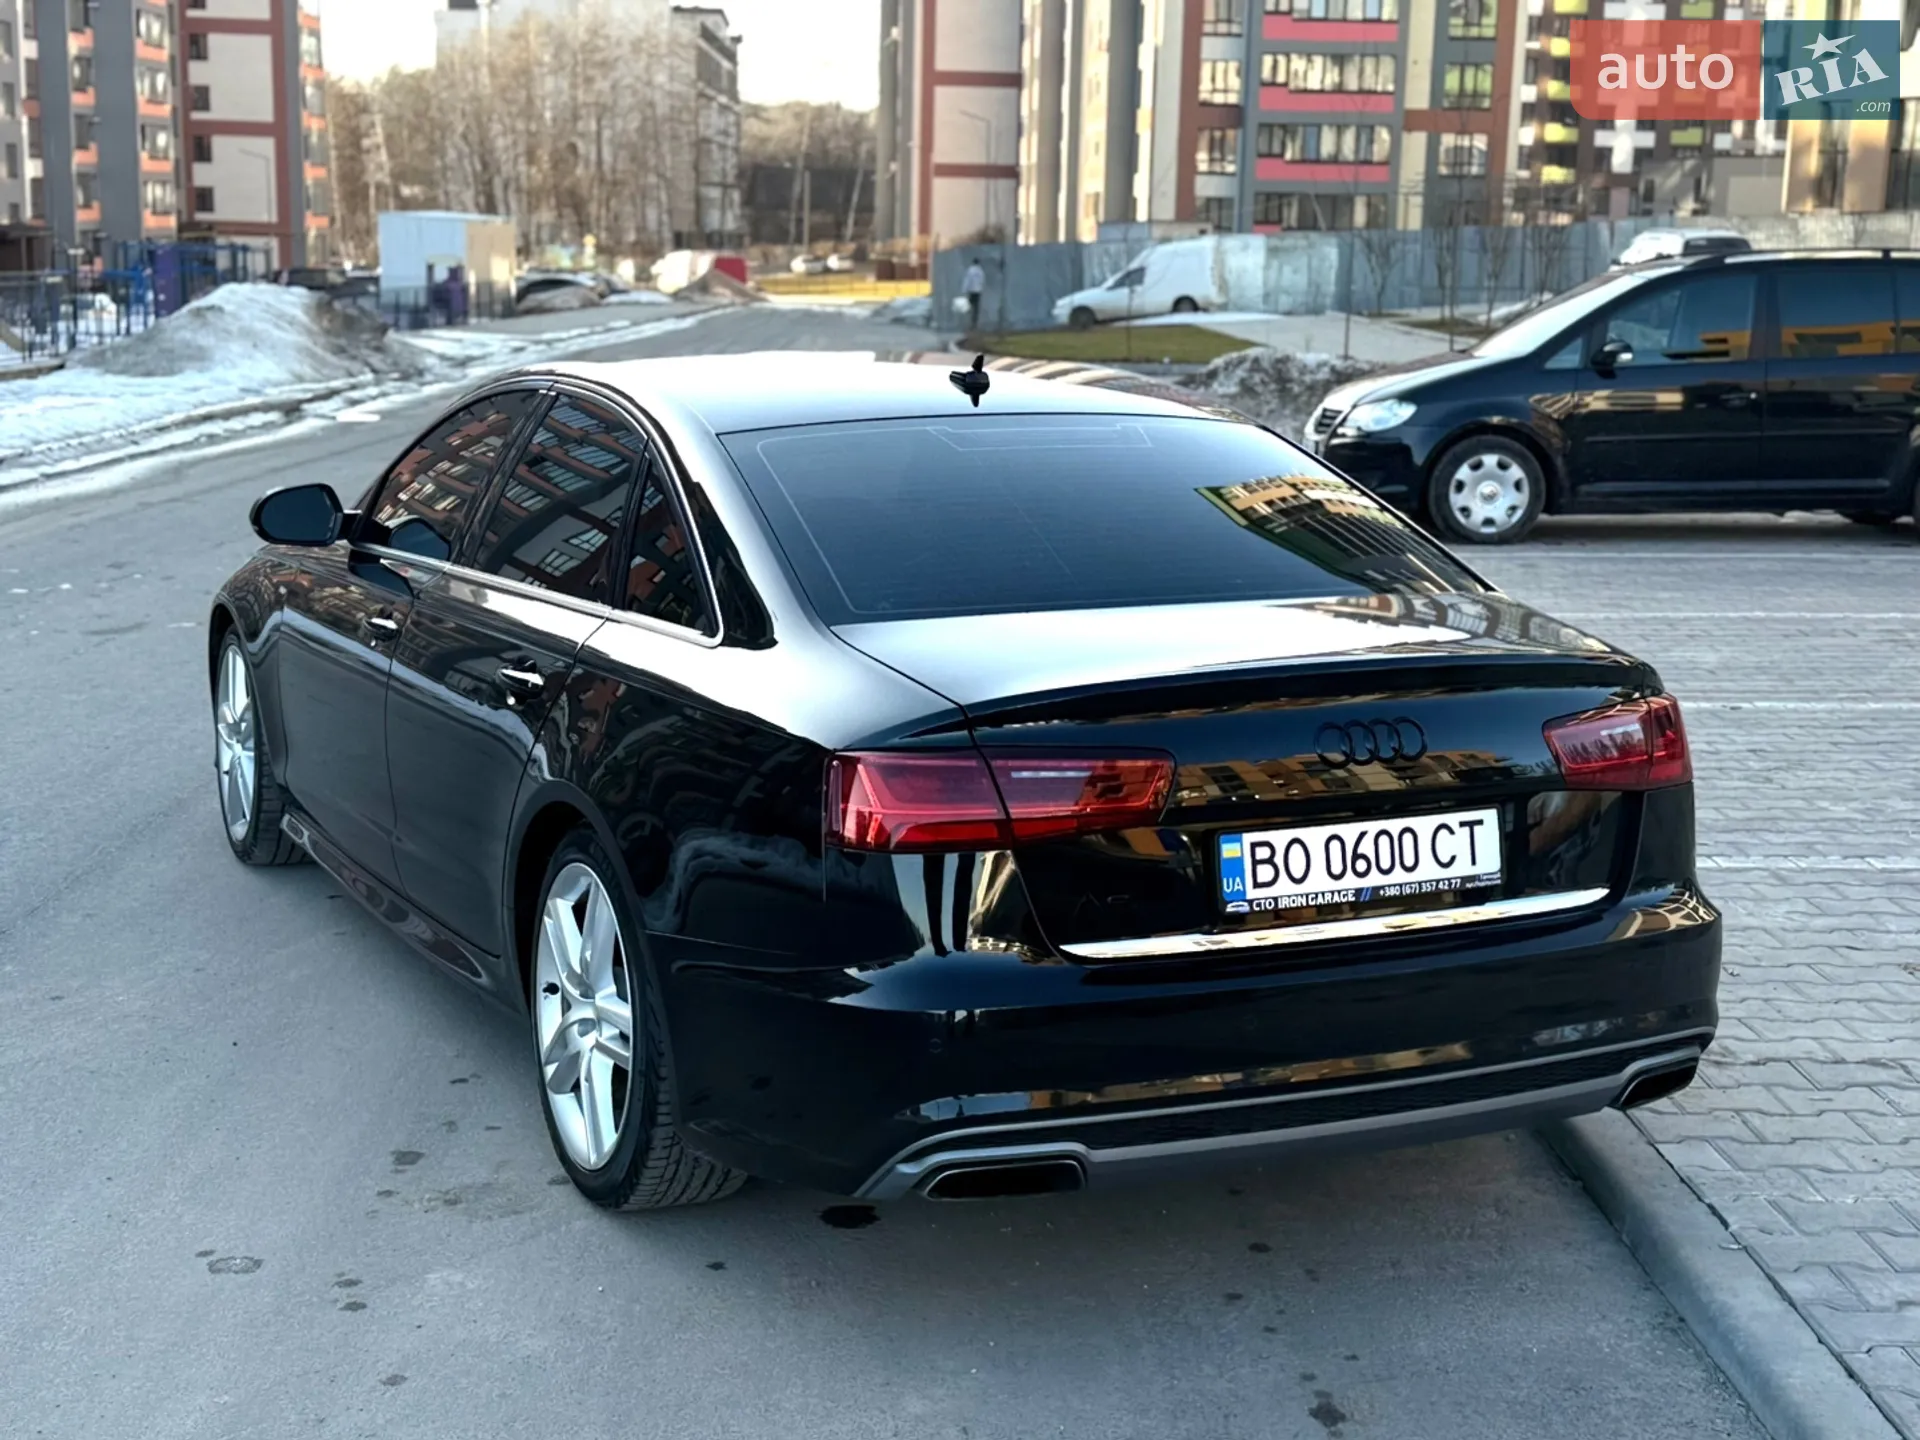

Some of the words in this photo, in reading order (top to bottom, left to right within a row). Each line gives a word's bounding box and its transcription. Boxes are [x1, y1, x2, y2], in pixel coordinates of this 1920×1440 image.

[1250, 837, 1311, 889] BO
[1324, 826, 1419, 881] 0600
[1431, 819, 1484, 869] CT
[1223, 877, 1244, 893] UA
[1278, 895, 1306, 909] IRON
[1308, 889, 1356, 905] GARAGE
[1379, 886, 1400, 897] +380
[1402, 882, 1419, 896] (67)
[1421, 881, 1436, 892] 357
[1450, 878, 1462, 889] 77
